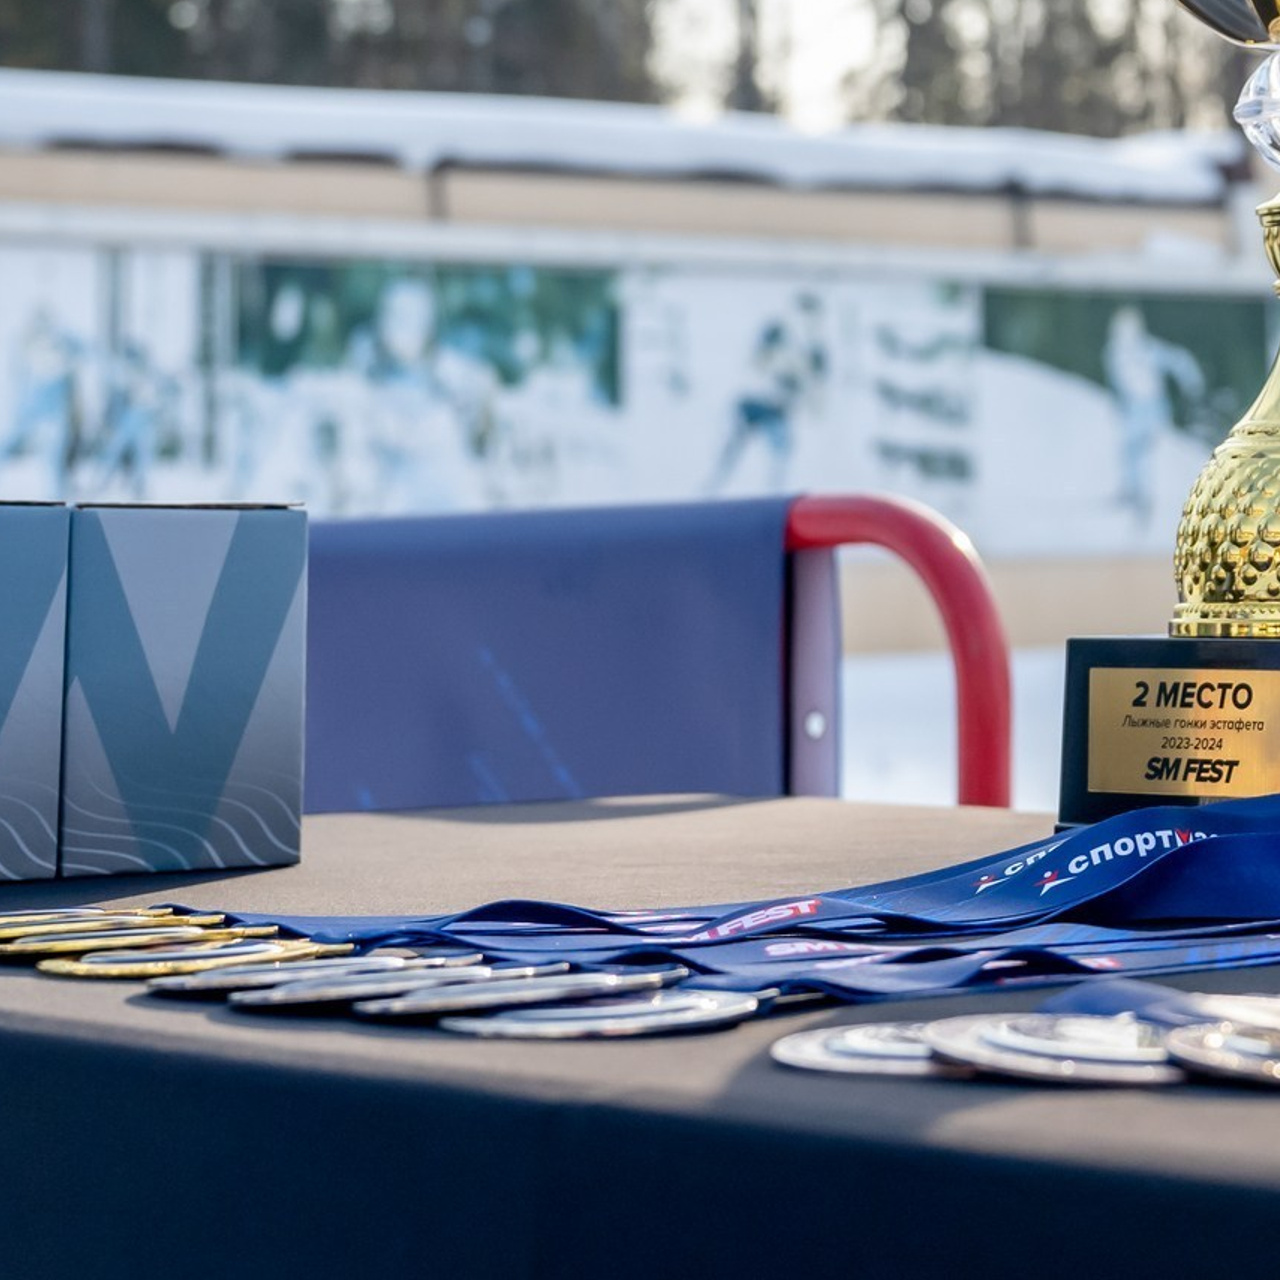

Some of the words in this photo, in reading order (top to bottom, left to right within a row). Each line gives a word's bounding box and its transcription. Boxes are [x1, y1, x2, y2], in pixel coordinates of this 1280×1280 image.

[1132, 681, 1149, 707] 2
[1155, 681, 1254, 709] МЕСТО
[1121, 714, 1171, 730] Лыжные
[1173, 717, 1207, 730] гонки
[1209, 716, 1265, 733] эстафета
[1161, 737, 1223, 751] 2023-2024
[1144, 756, 1184, 782] SM
[1182, 759, 1239, 784] FEST
[715, 898, 822, 936] FEST
